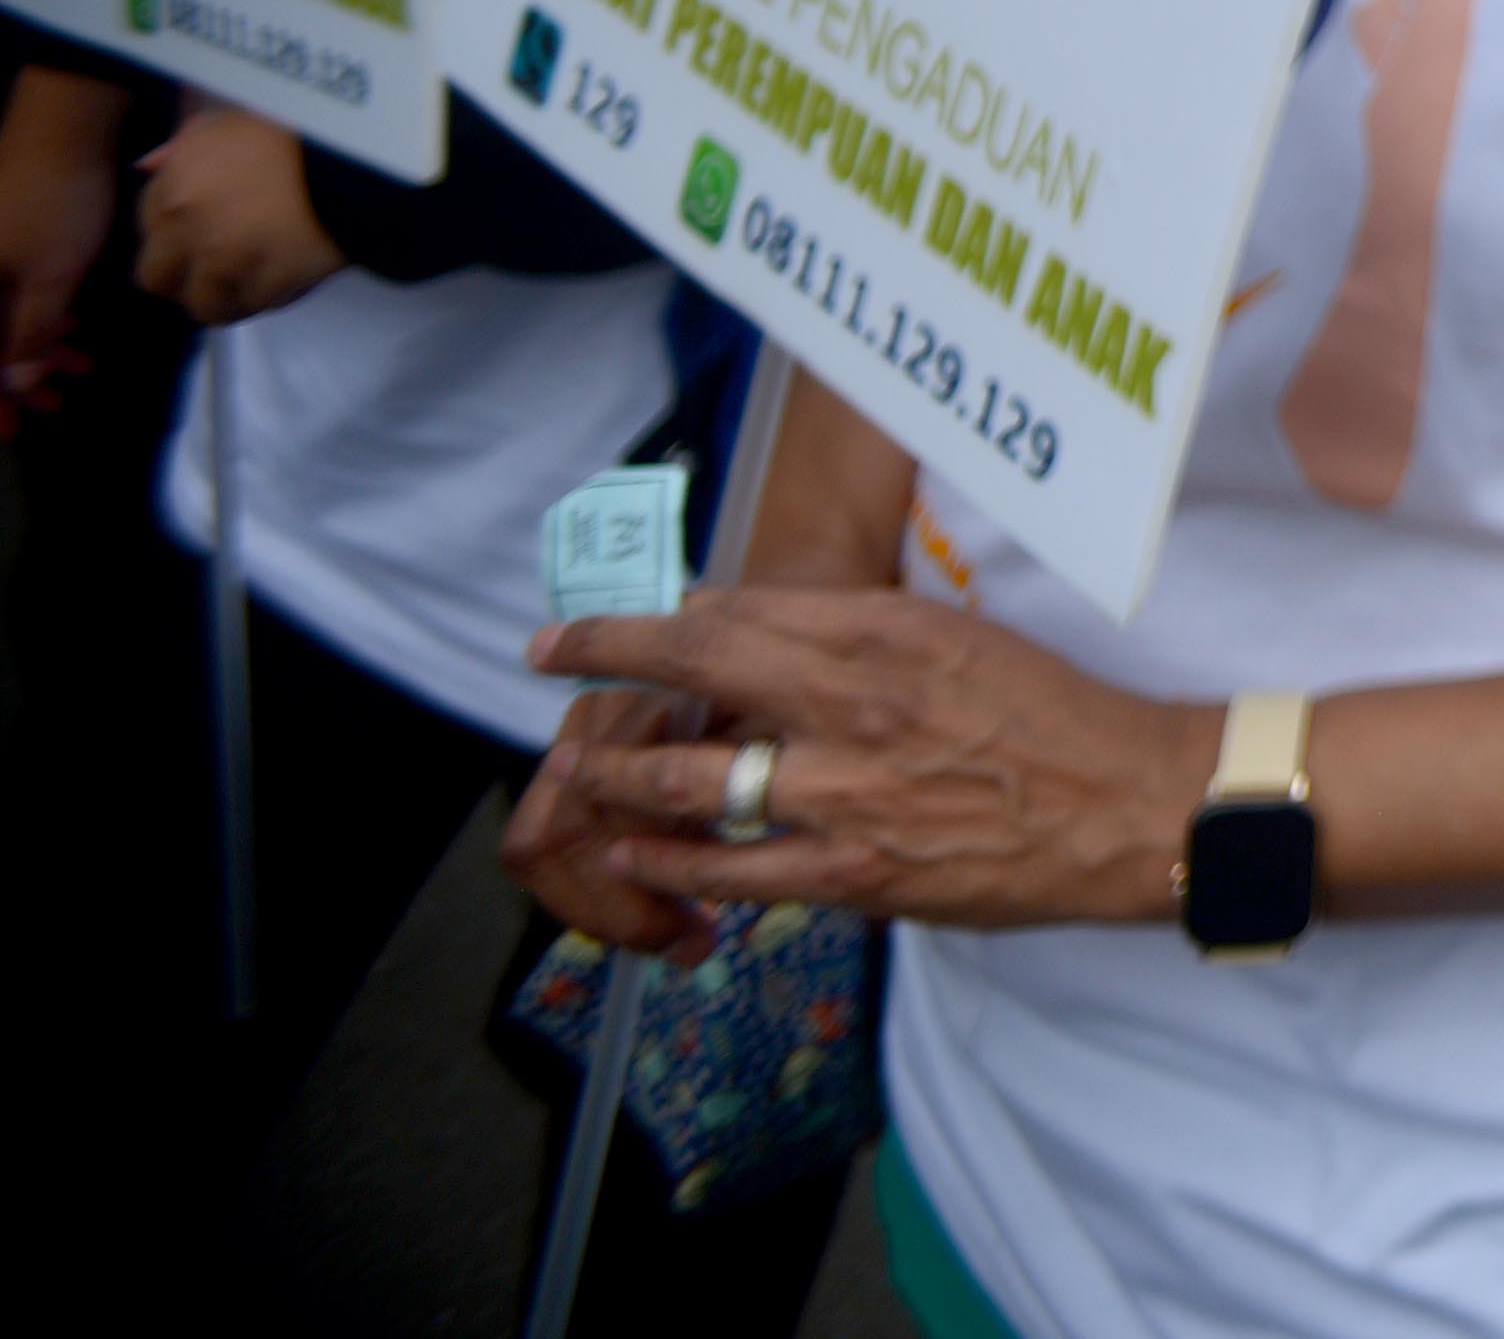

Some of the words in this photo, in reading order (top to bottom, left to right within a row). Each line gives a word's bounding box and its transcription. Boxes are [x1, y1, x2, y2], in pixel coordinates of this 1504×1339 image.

[565, 62, 642, 151] 129
[742, 195, 1059, 482] 08111.129.129
[922, 173, 1031, 309] DAN
[1024, 255, 1174, 421] ANAK
